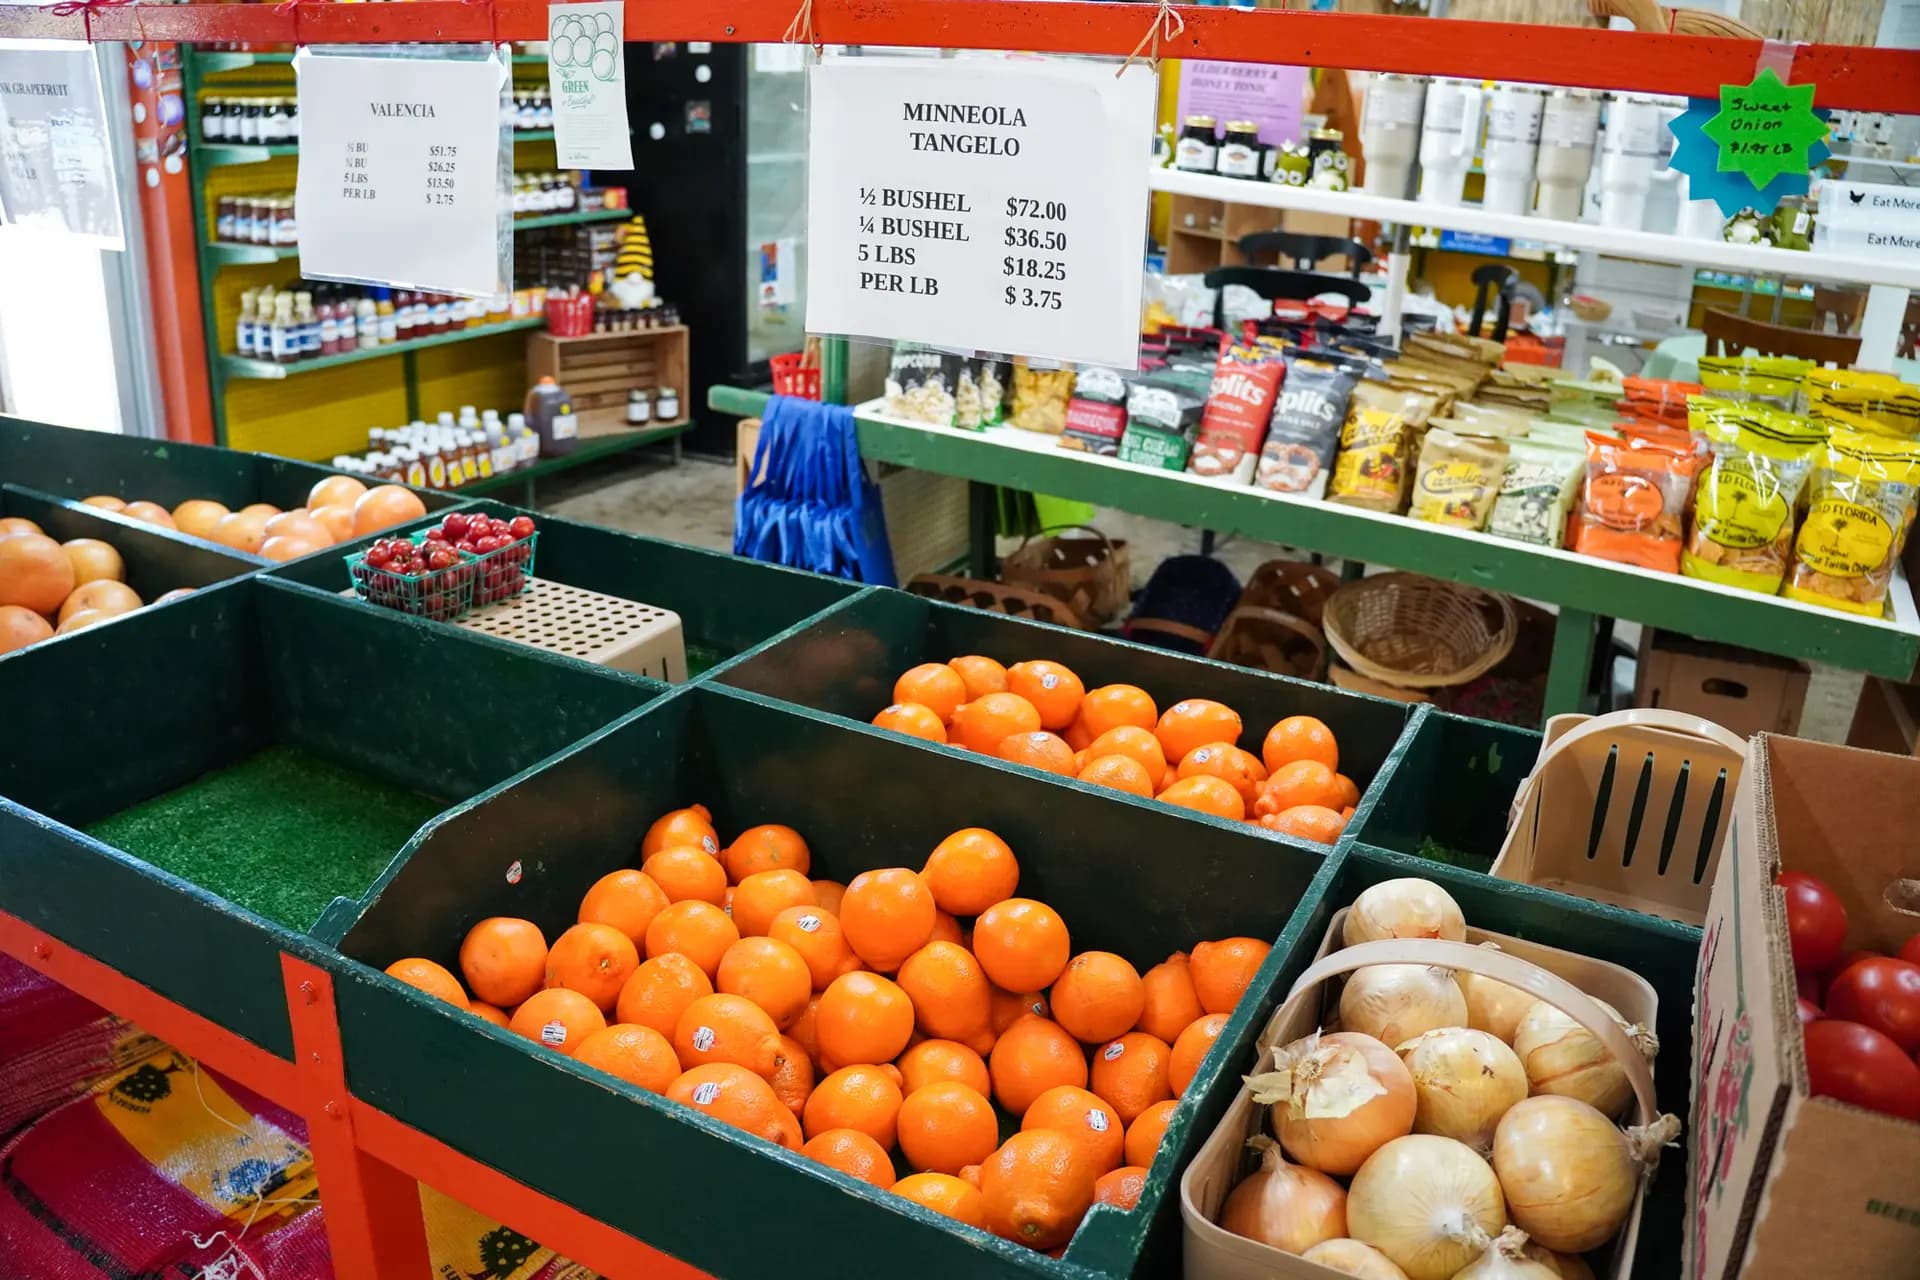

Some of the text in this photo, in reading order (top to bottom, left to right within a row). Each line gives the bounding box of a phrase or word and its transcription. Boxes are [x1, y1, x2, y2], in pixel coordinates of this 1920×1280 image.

[12, 83, 68, 97] GRAPEFRUIT
[562, 80, 590, 93] GREEN
[370, 102, 436, 118] VALENCIA
[1730, 98, 1792, 112] Sweet
[903, 102, 1027, 127] MINNEOLA
[356, 142, 368, 153] BU
[429, 146, 457, 157] $51.75
[910, 132, 1020, 156] TANGELO
[355, 158, 367, 168] BU
[428, 161, 456, 173] $26.25
[343, 173, 454, 189] 5 LBS $13.50
[343, 188, 454, 205] PER LB $ 2.75
[859, 187, 1066, 221] ½ BUSHEL $72.00
[1872, 195, 1920, 210] Eat More
[859, 215, 1066, 251] ¼ BUSHEL $36.50
[1867, 232, 1920, 249] Eat More
[858, 244, 1066, 281] 5 LBS $18.25
[859, 272, 1062, 310] PER LB $ 3.75
[1833, 504, 1878, 527] FLORIDA
